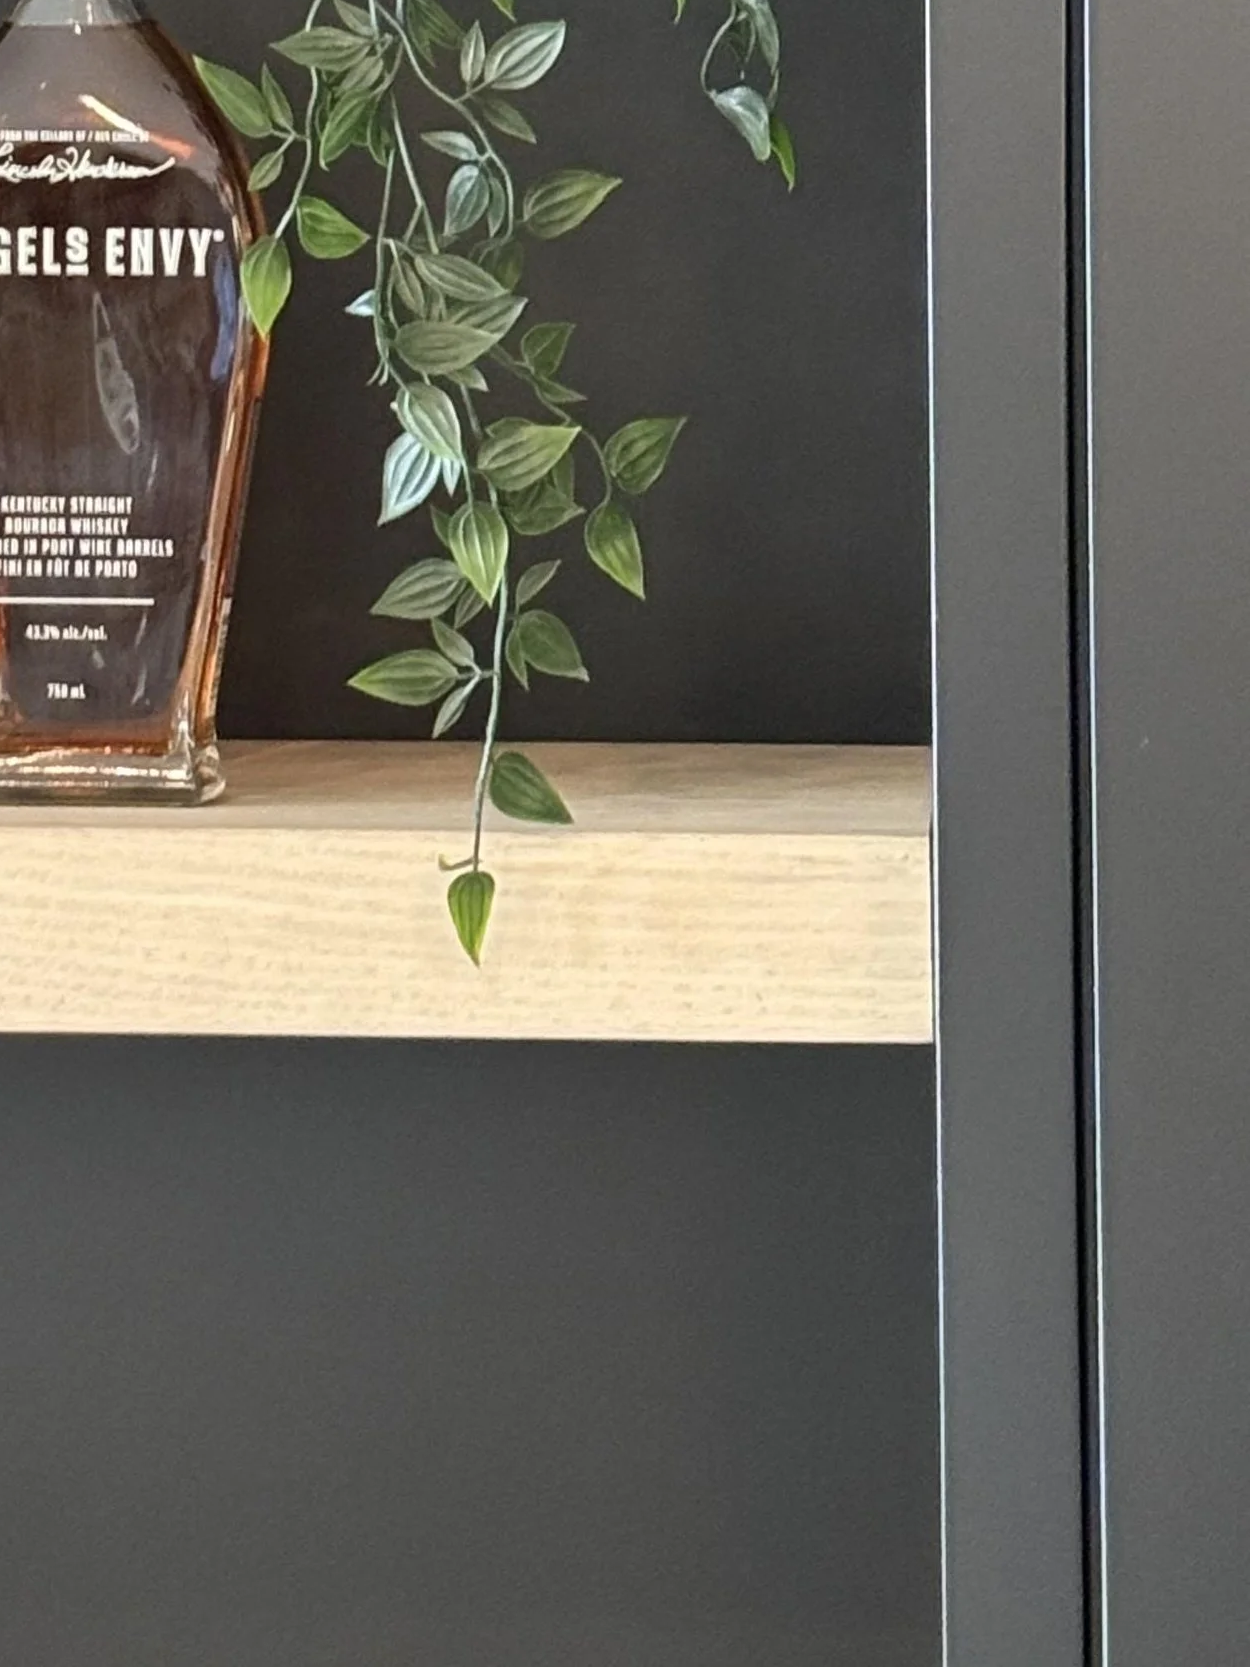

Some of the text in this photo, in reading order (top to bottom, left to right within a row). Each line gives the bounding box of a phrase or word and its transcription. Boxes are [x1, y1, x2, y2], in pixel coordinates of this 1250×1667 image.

[105, 227, 213, 277] ENVY
[0, 496, 133, 514] KENTUCKY STRAIGHT
[4, 517, 129, 535] BOURBON WHISKEY
[23, 537, 38, 556] IN
[41, 537, 75, 556] PORT
[78, 537, 112, 557] WINE
[116, 537, 174, 557] BARRELS
[25, 559, 43, 577] EN
[74, 559, 91, 577] DE
[95, 559, 138, 578] PORTO
[47, 683, 69, 699] 750
